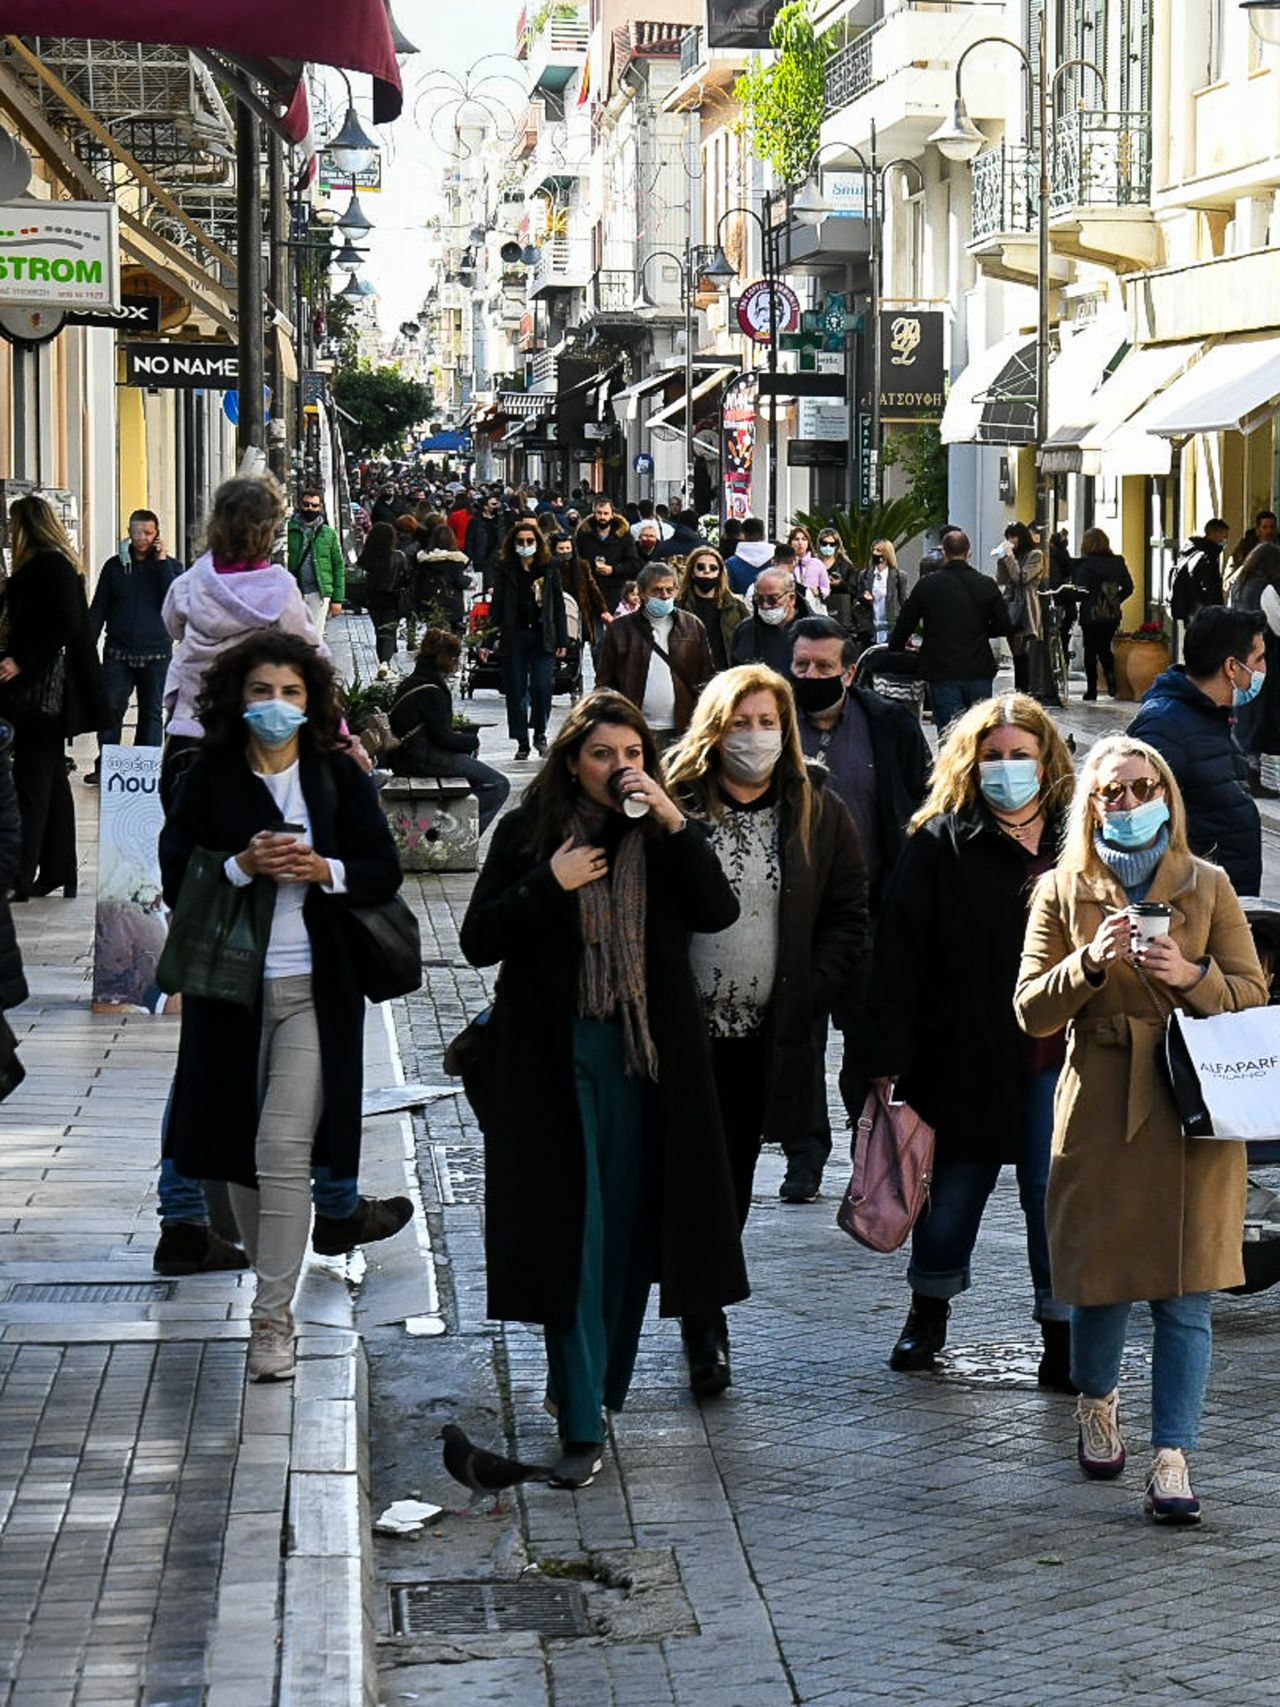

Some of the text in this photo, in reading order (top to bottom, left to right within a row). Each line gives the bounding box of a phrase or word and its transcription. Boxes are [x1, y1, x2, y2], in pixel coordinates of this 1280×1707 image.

[72, 305, 149, 320] OX
[133, 356, 239, 377] NO NAME
[868, 391, 942, 406] ΑΤΣΟΥΦΗ
[108, 772, 161, 794] Λου
[1200, 1055, 1279, 1074] ALFAPARF
